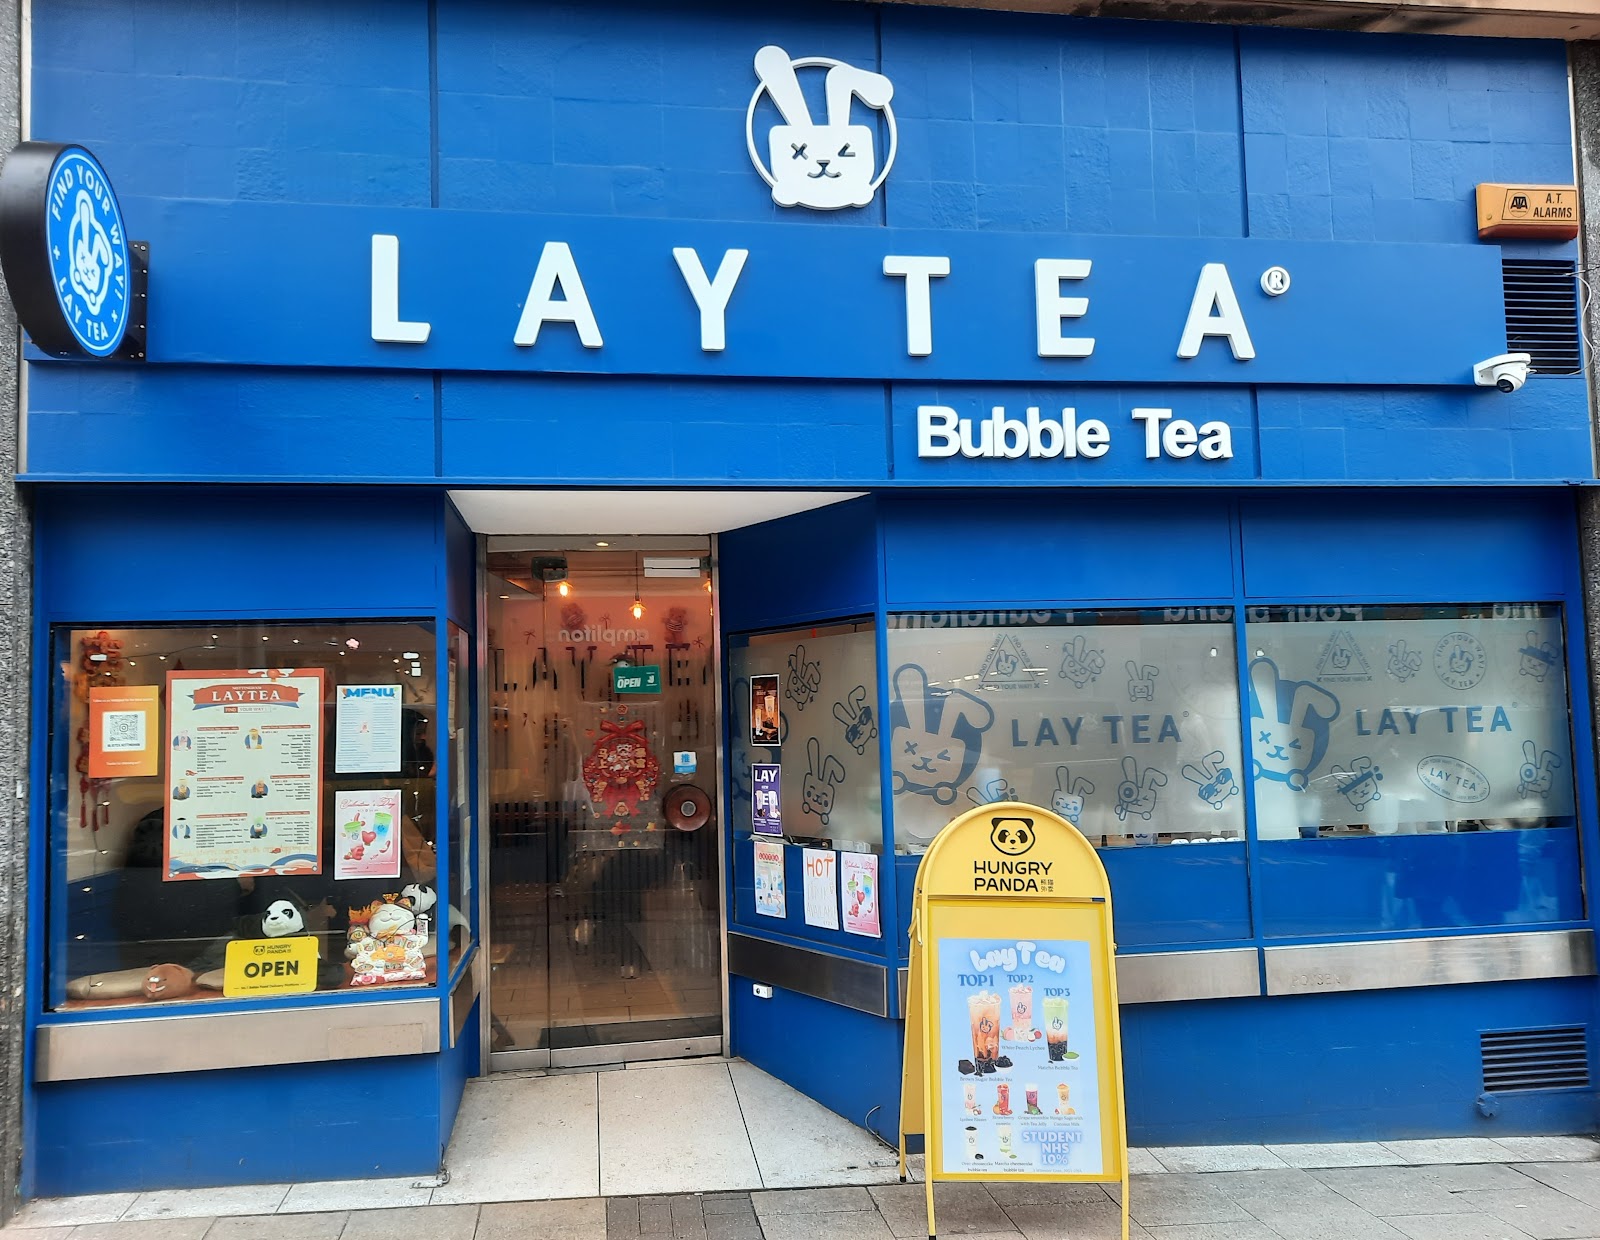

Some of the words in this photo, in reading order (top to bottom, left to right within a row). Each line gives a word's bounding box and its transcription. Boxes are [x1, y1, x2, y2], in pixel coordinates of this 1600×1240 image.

[51, 168, 74, 222] FIND
[76, 164, 111, 216] YOUR
[1545, 193, 1563, 204] A.T.
[1533, 207, 1572, 218] ALARMS
[371, 234, 749, 352] LAY
[58, 276, 82, 324] LAY
[86, 318, 109, 341] TEA
[916, 405, 1111, 460] Bubble
[1131, 407, 1234, 461] Tea
[1451, 634, 1474, 643] YOUR
[617, 678, 641, 689] OPEN
[1441, 672, 1456, 685] LAY
[1458, 679, 1474, 687] TEA
[212, 690, 281, 702] LAYTEA
[345, 687, 395, 698] MENU
[1356, 707, 1420, 736] LAY
[1011, 716, 1085, 748] LAY
[755, 769, 778, 783] LAY
[1430, 767, 1452, 781] LAY
[1456, 776, 1476, 792] TEA
[806, 855, 834, 878] HOT
[973, 860, 1053, 875] HUNGRY
[974, 877, 1039, 892] PANDA
[244, 960, 299, 979] OPEN
[1022, 1131, 1082, 1143] STUDENT
[1041, 1143, 1069, 1153] NHS
[1042, 1154, 1068, 1165] 10%
